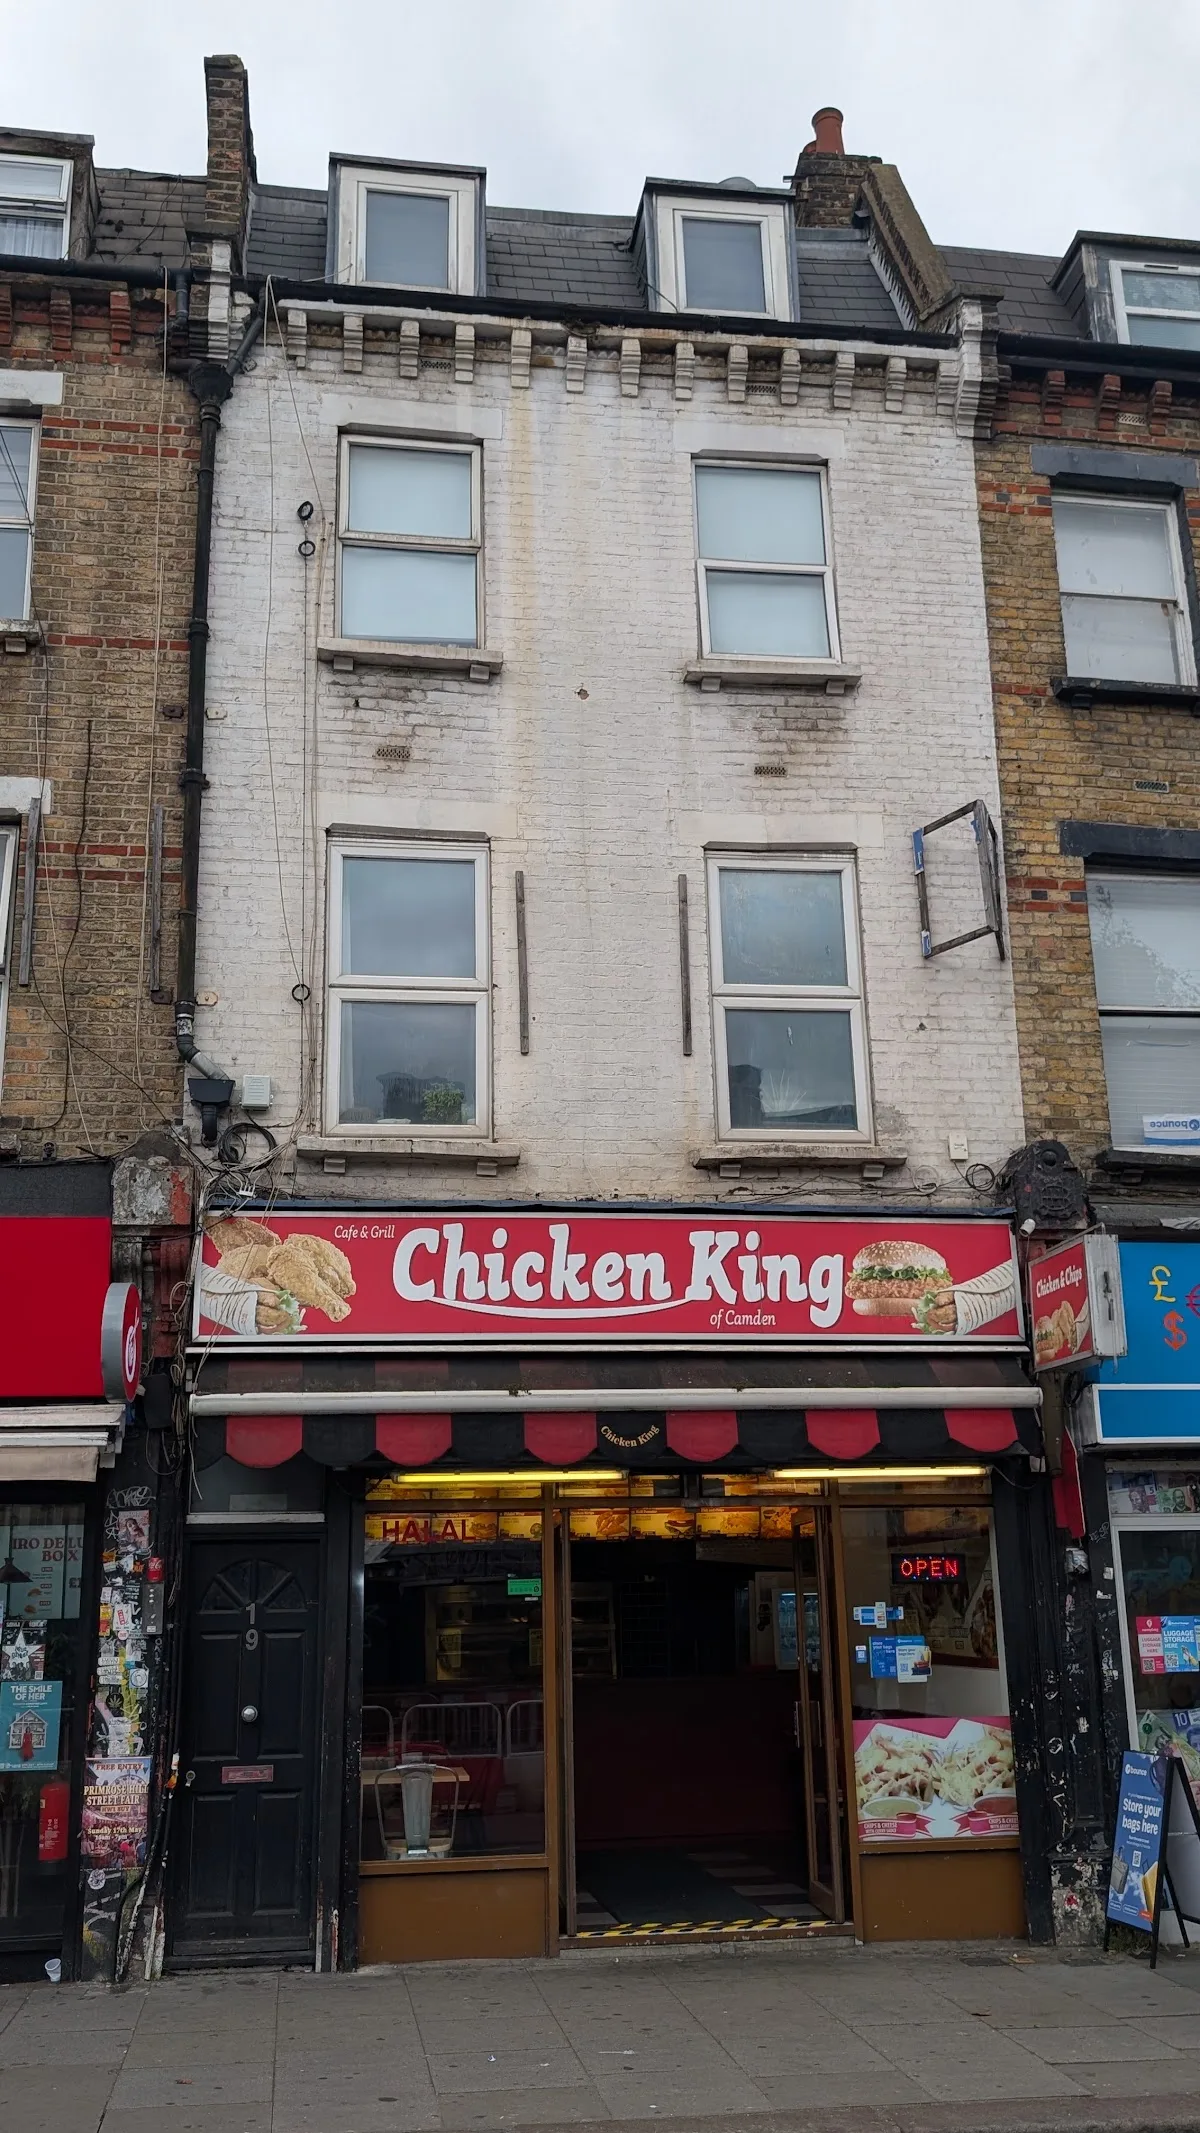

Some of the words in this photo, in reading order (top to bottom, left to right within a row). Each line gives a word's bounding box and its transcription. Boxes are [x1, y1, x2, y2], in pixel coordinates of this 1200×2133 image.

[334, 1224, 358, 1241] Cafe
[360, 1225, 368, 1239] &
[370, 1224, 395, 1238] Grill
[392, 1222, 672, 1302] Chicken
[685, 1230, 845, 1328] King
[1036, 1275, 1060, 1298] Chicken
[1060, 1270, 1066, 1288] &
[1065, 1264, 1083, 1287] Chips
[709, 1308, 724, 1329] of
[725, 1309, 776, 1326] Camden
[600, 1425, 637, 1448] Chicken
[637, 1424, 660, 1445] King
[382, 1519, 477, 1544] HALAL
[901, 1560, 958, 1576] OPEN
[10, 1685, 27, 1693] THE
[28, 1685, 52, 1693] SMILE
[1174, 1712, 1188, 1727] 10
[1130, 1766, 1147, 1776] bounce
[83, 1785, 127, 1796] PRIMROSE
[129, 1784, 148, 1794] HILL
[86, 1795, 119, 1806] STREET
[120, 1795, 140, 1805] FAIR
[1123, 1798, 1143, 1814] Store
[1143, 1804, 1161, 1819] your
[87, 1826, 111, 1836] Sunday
[113, 1826, 127, 1834] 17th
[1122, 1815, 1141, 1834] bags
[1141, 1819, 1159, 1835] here
